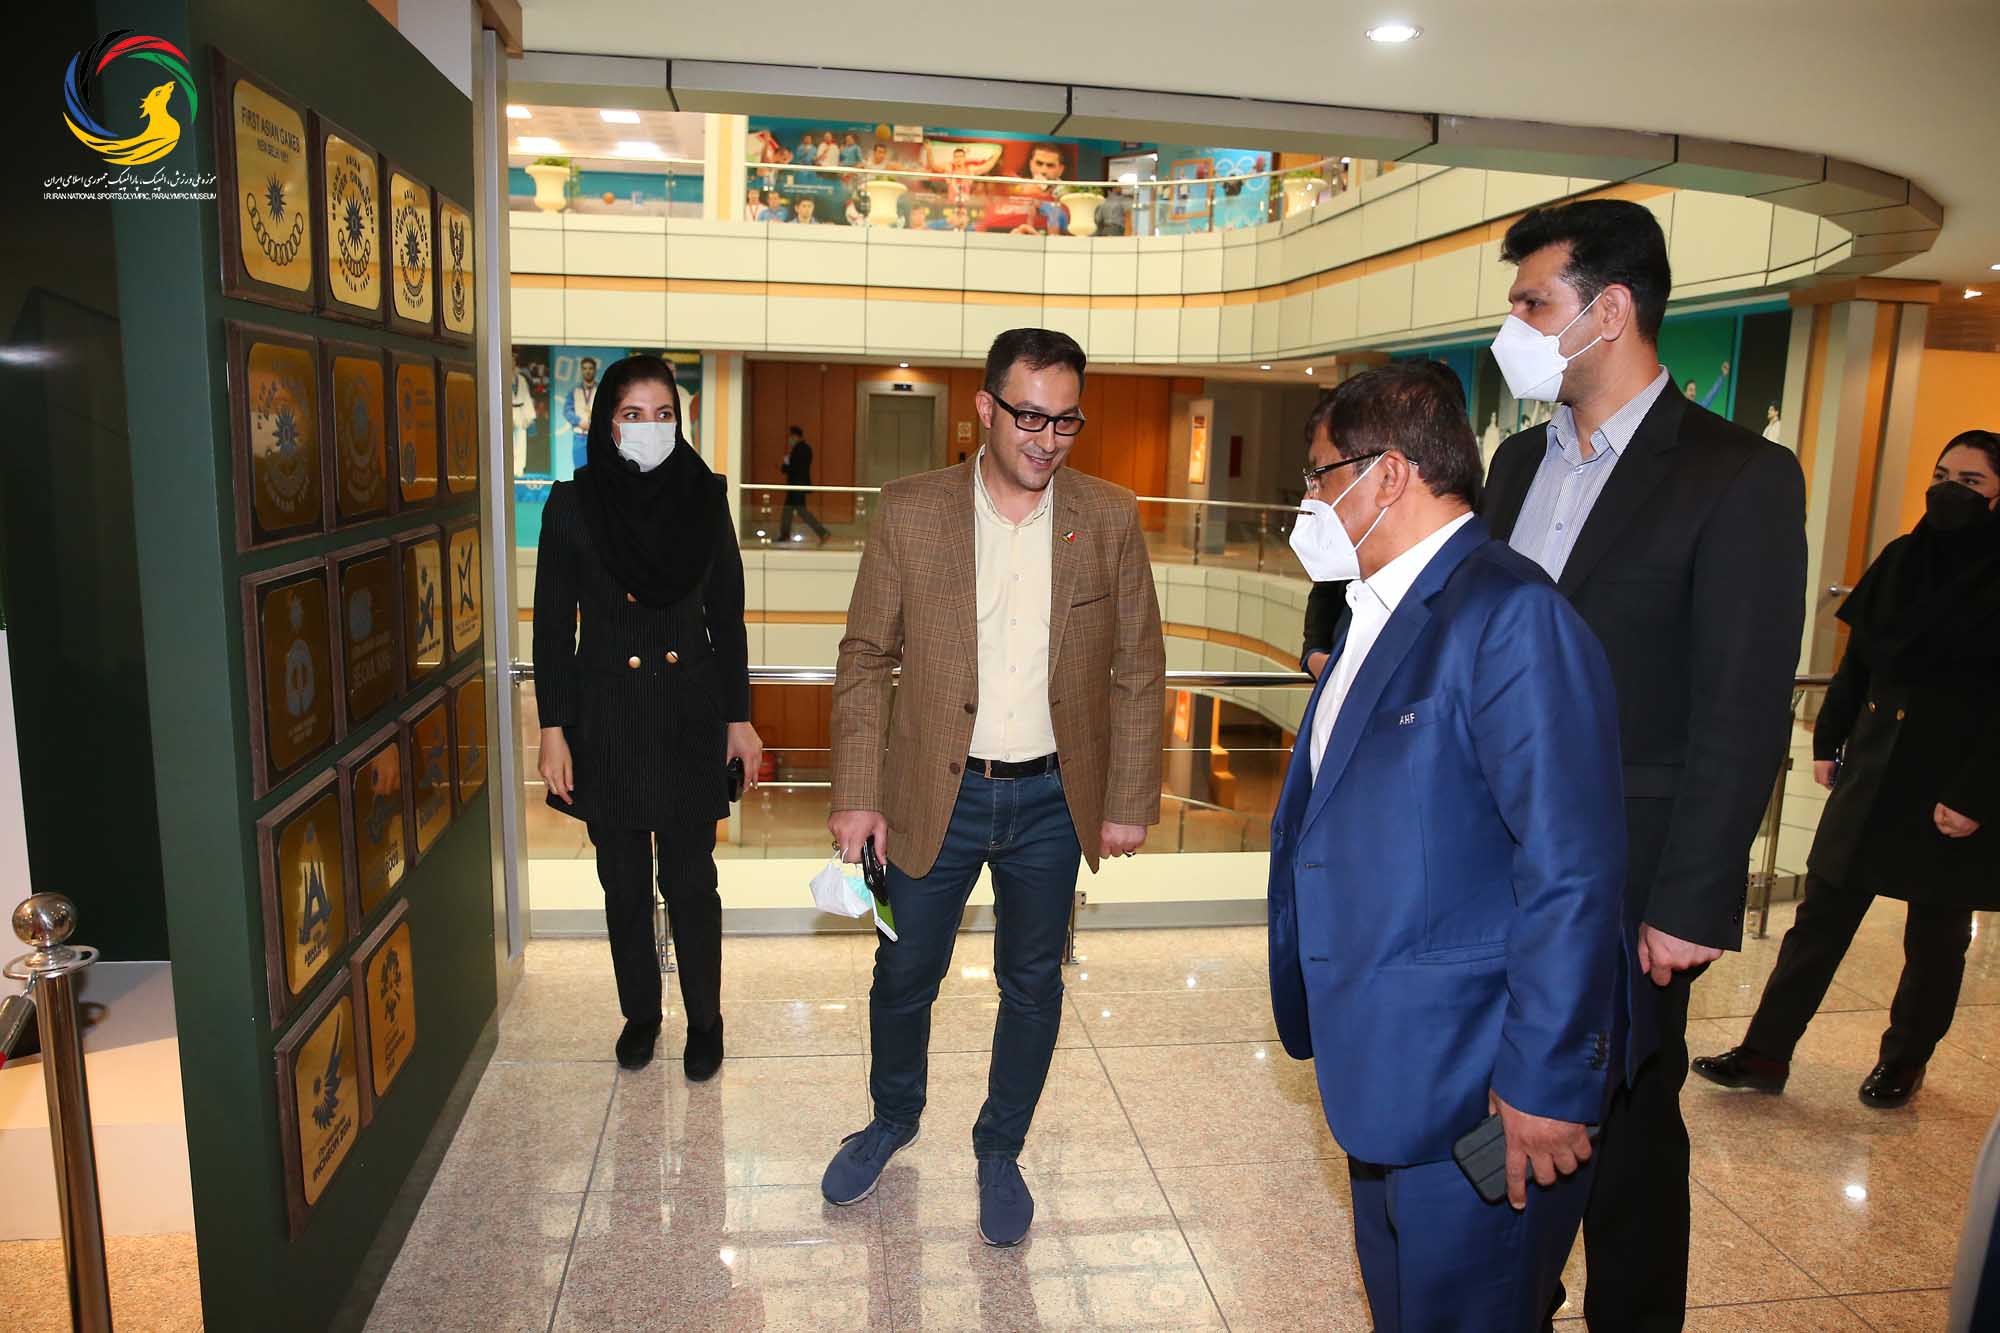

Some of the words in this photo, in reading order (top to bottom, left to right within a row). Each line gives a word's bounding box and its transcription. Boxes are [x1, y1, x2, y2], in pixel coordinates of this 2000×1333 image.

[241, 106, 260, 132] FIRST
[260, 117, 280, 144] ASIAN
[280, 127, 300, 153] GAMES
[1399, 712, 1416, 726] AHF
[312, 1131, 340, 1184] INCHEON
